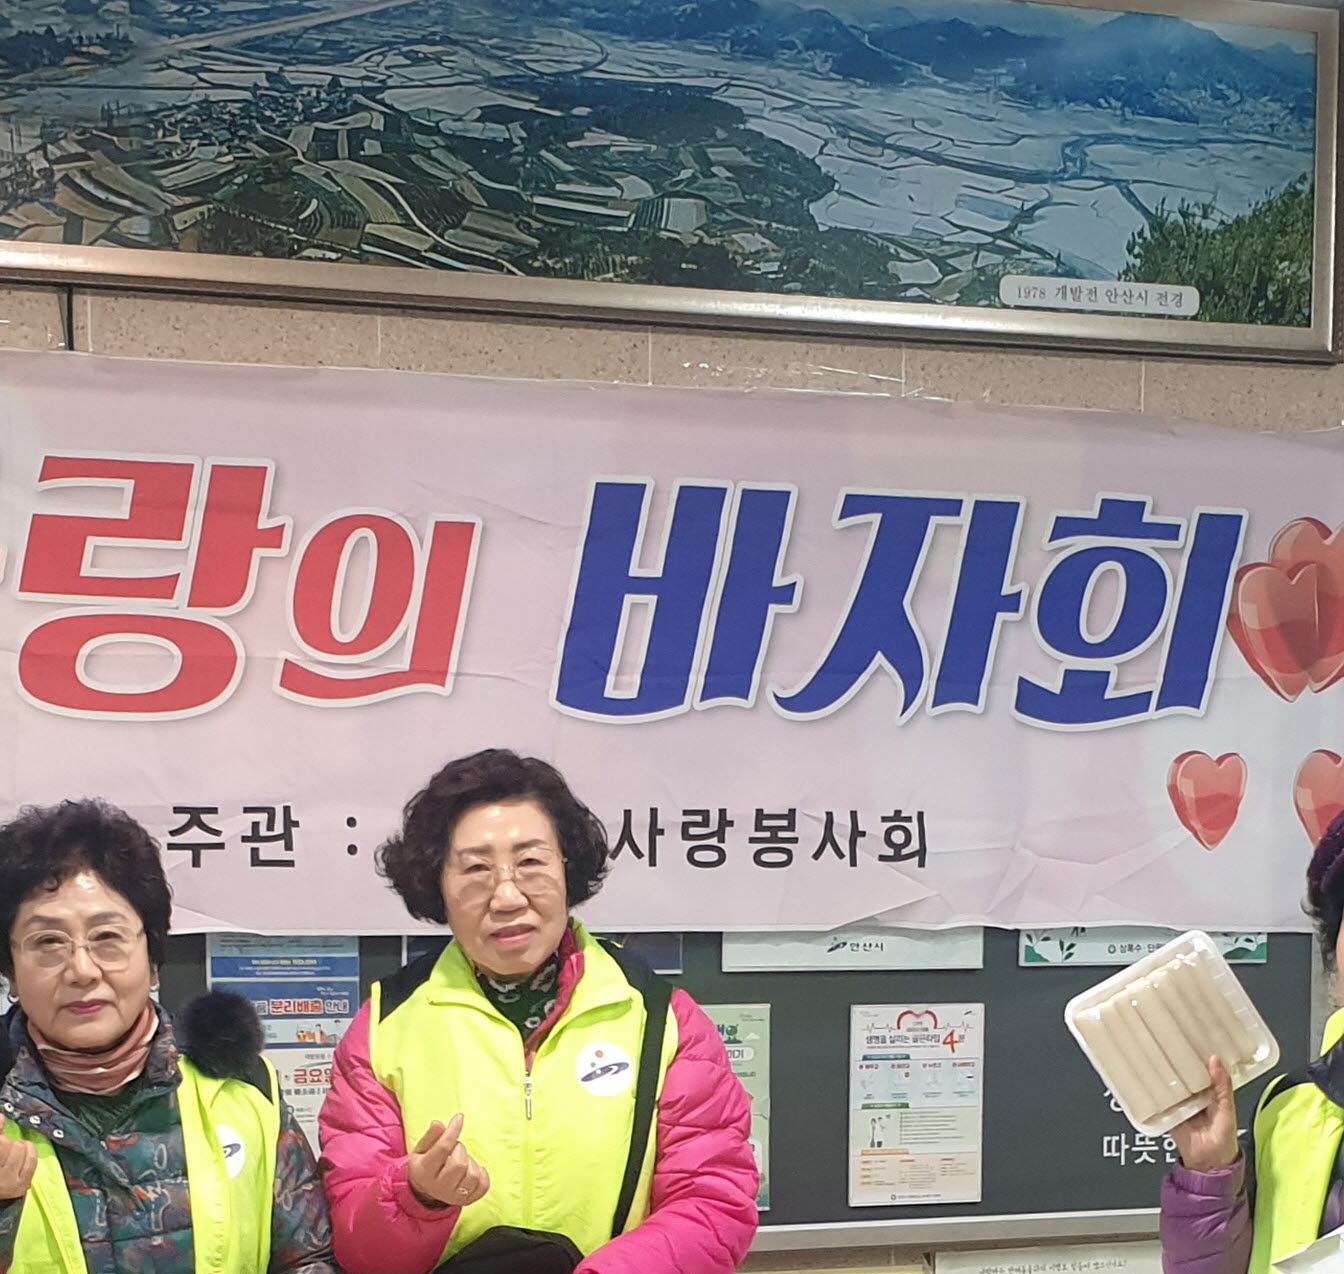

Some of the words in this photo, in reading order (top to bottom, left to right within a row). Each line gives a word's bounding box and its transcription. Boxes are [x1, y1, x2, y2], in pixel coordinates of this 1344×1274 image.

[1015, 286, 1047, 300] 1978
[1055, 287, 1098, 304] 개발전
[1105, 289, 1149, 307] 안산시
[1156, 292, 1184, 308] 전경
[553, 478, 1245, 728] 바자회
[166, 805, 301, 867] 주관
[609, 807, 929, 870] 사랑봉사회
[849, 941, 884, 952] 안산시
[269, 998, 324, 1015] 분리배출
[325, 999, 349, 1014] 안내
